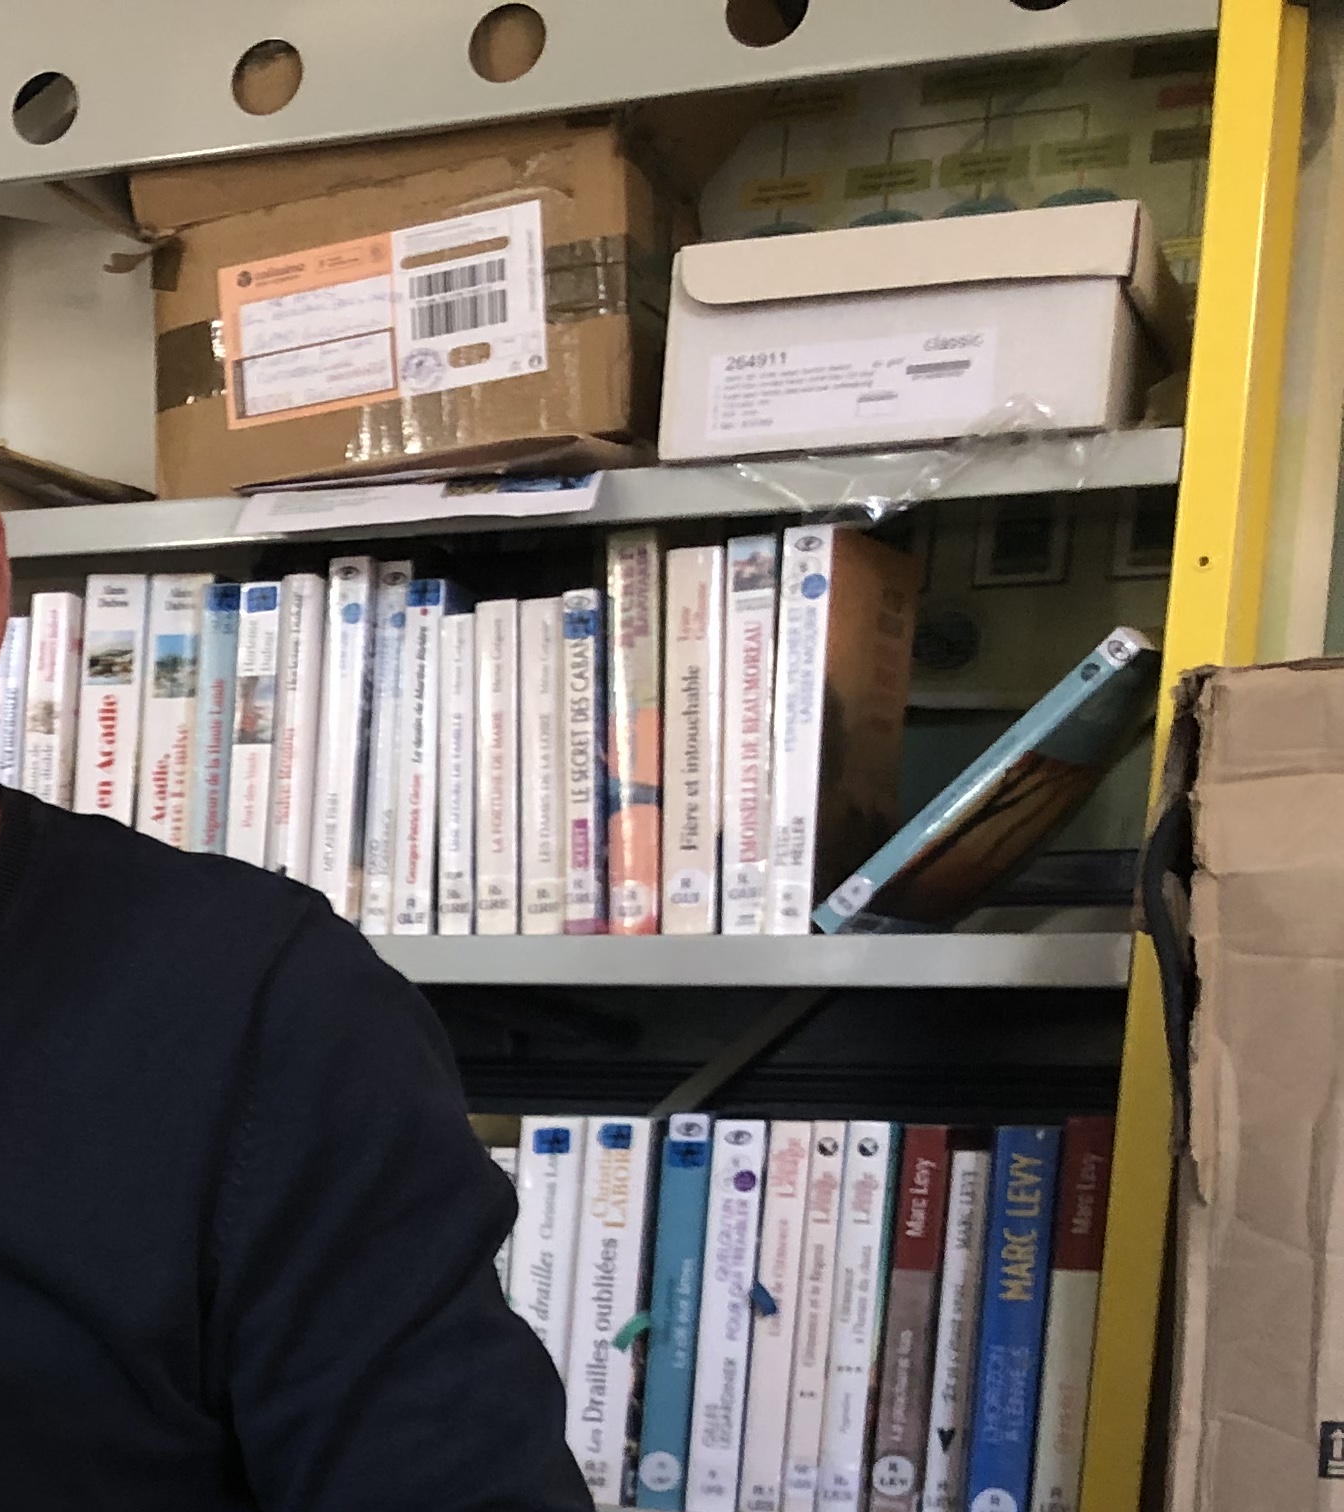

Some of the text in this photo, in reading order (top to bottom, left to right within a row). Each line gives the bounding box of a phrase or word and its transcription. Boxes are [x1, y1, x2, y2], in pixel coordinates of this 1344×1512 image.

[95, 693, 118, 810] en Acadie
[571, 697, 590, 804] LE SECRET DES
[676, 664, 700, 851] Fière et intouchable
[905, 1158, 936, 1238] Marc Levy
[1005, 1152, 1044, 1217] LEVY
[997, 1228, 1038, 1301] MARC
[580, 1237, 619, 1423] Drailles oubliées
